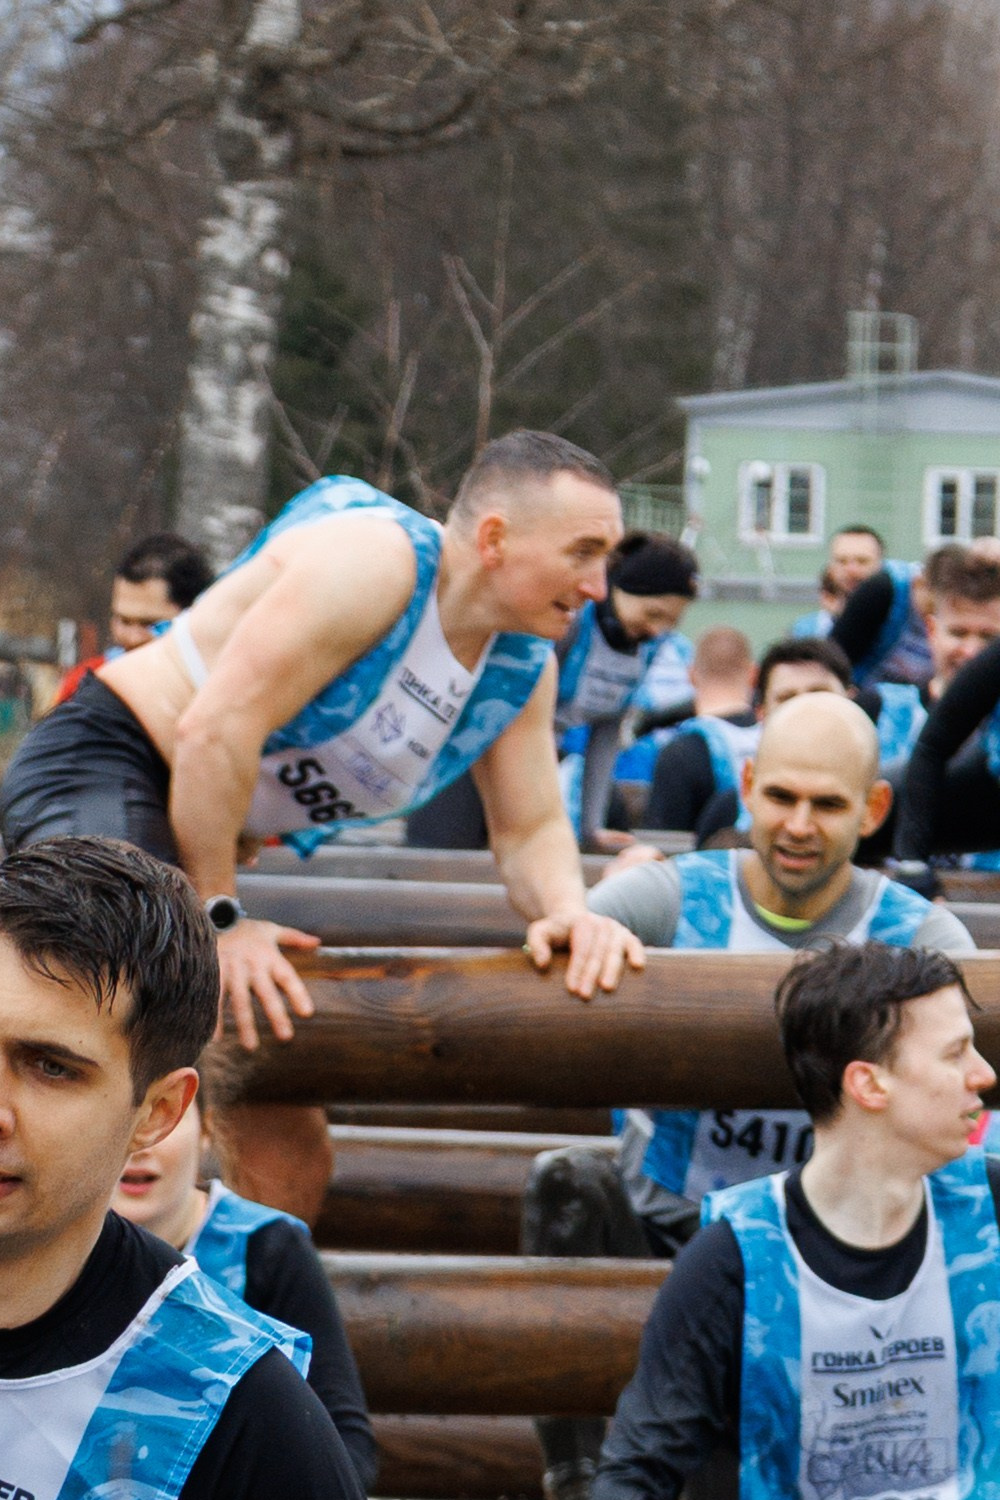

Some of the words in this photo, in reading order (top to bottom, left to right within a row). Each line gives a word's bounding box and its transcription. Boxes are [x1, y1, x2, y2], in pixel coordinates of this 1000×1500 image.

[277, 757, 367, 823] 566
[811, 1350, 877, 1368] ГОНКА
[833, 1375, 926, 1409] Sminex
